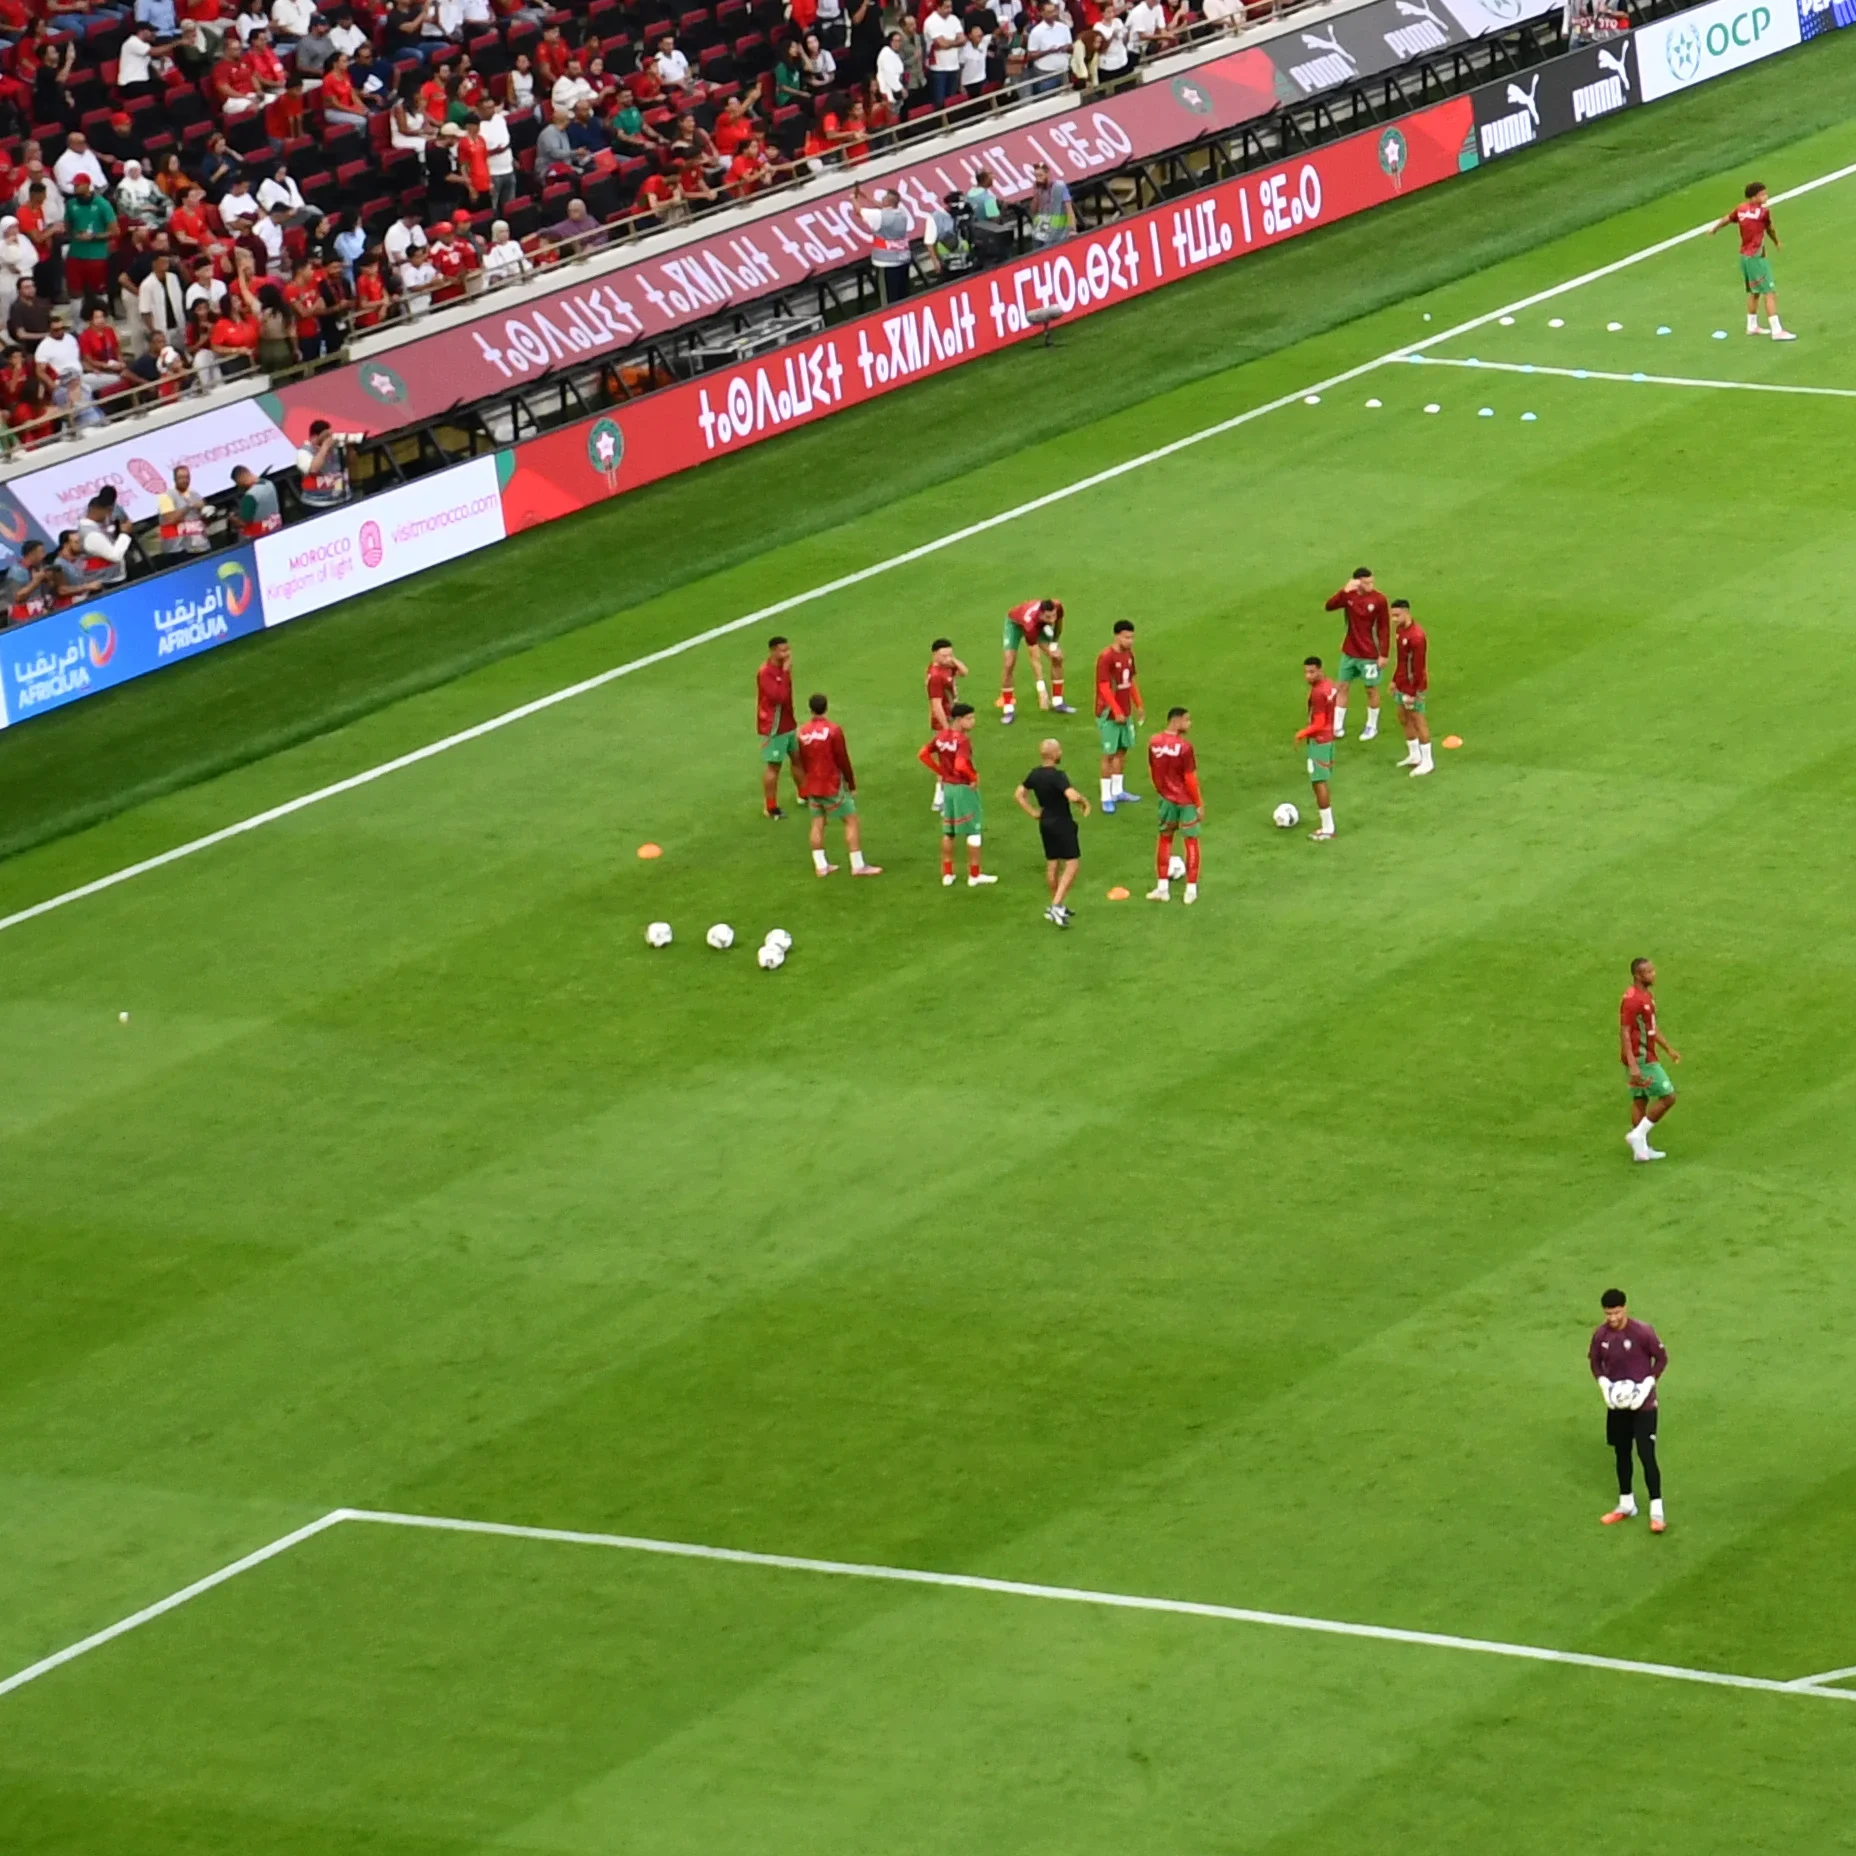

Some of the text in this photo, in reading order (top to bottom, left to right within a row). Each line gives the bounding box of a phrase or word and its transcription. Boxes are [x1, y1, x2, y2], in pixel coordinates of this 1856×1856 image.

[1384, 19, 1448, 59] PUMA
[1706, 6, 1771, 56] OCP
[1290, 52, 1355, 93] PUMA
[1573, 74, 1625, 122] PUMA
[1480, 109, 1535, 158] PUMA
[391, 493, 498, 545] visitmorocco.com
[288, 537, 350, 571] MOROCCO
[158, 614, 228, 657] AFRIQUIA
[18, 665, 91, 710] AFRIQUIA
